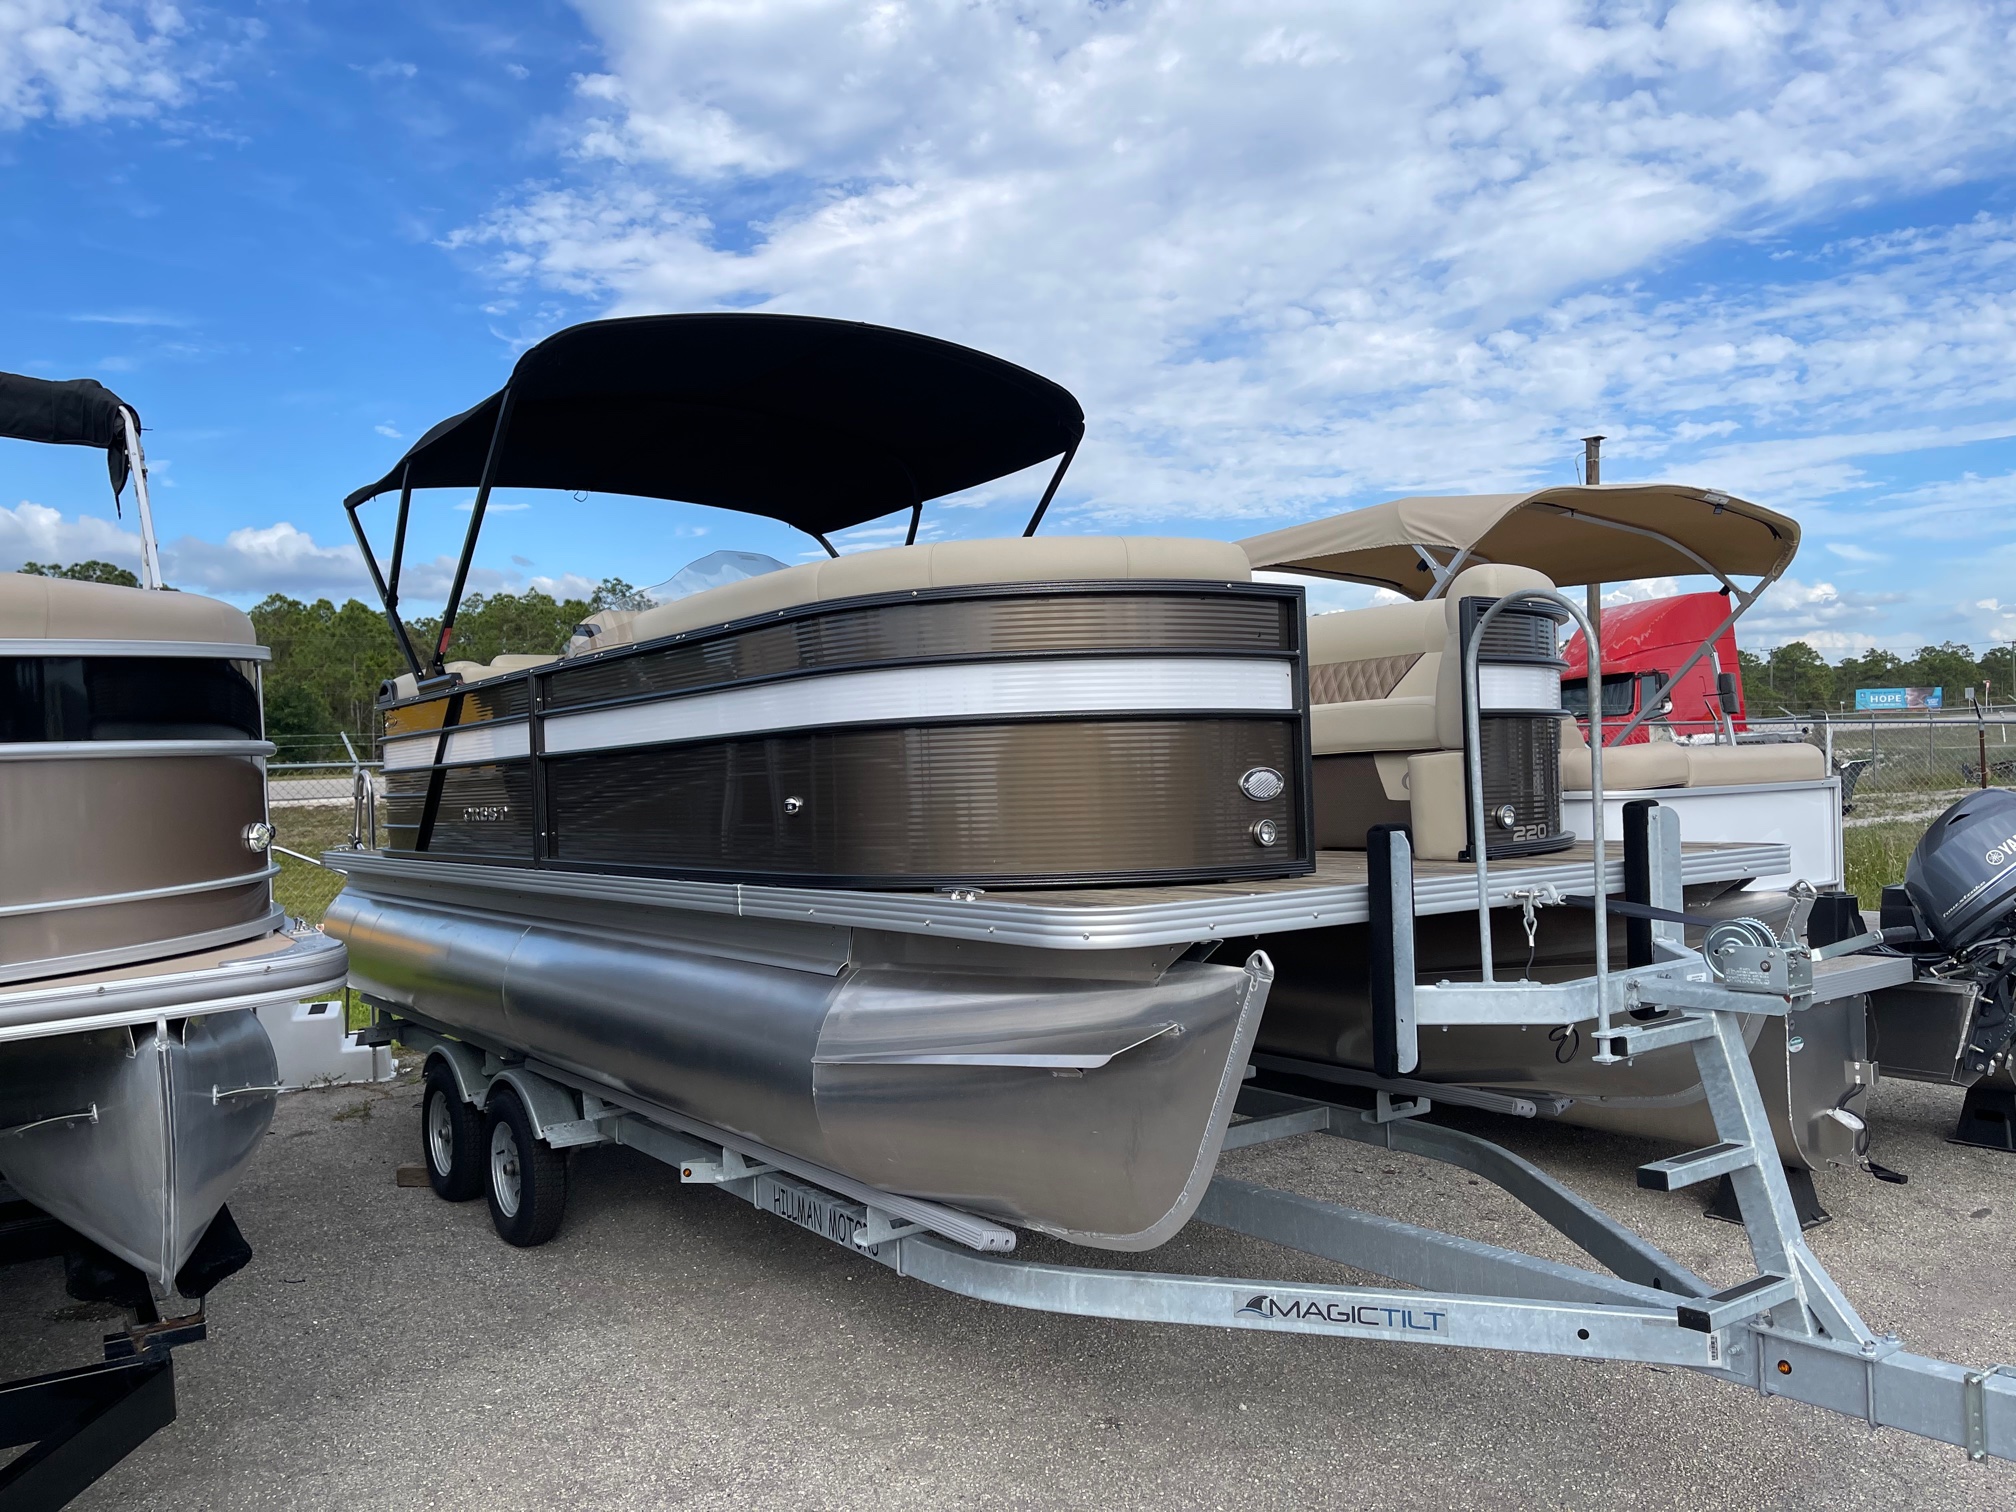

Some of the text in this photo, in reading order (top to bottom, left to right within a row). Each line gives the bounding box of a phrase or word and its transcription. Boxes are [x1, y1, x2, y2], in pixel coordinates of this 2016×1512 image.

[1870, 695, 1902, 703] HOPE
[463, 806, 508, 821] CREST
[1513, 823, 1547, 842] 220
[1997, 834, 2016, 855] YA
[773, 1184, 822, 1232] HILLMAN
[1269, 1298, 1446, 1331] MAGICTILT
